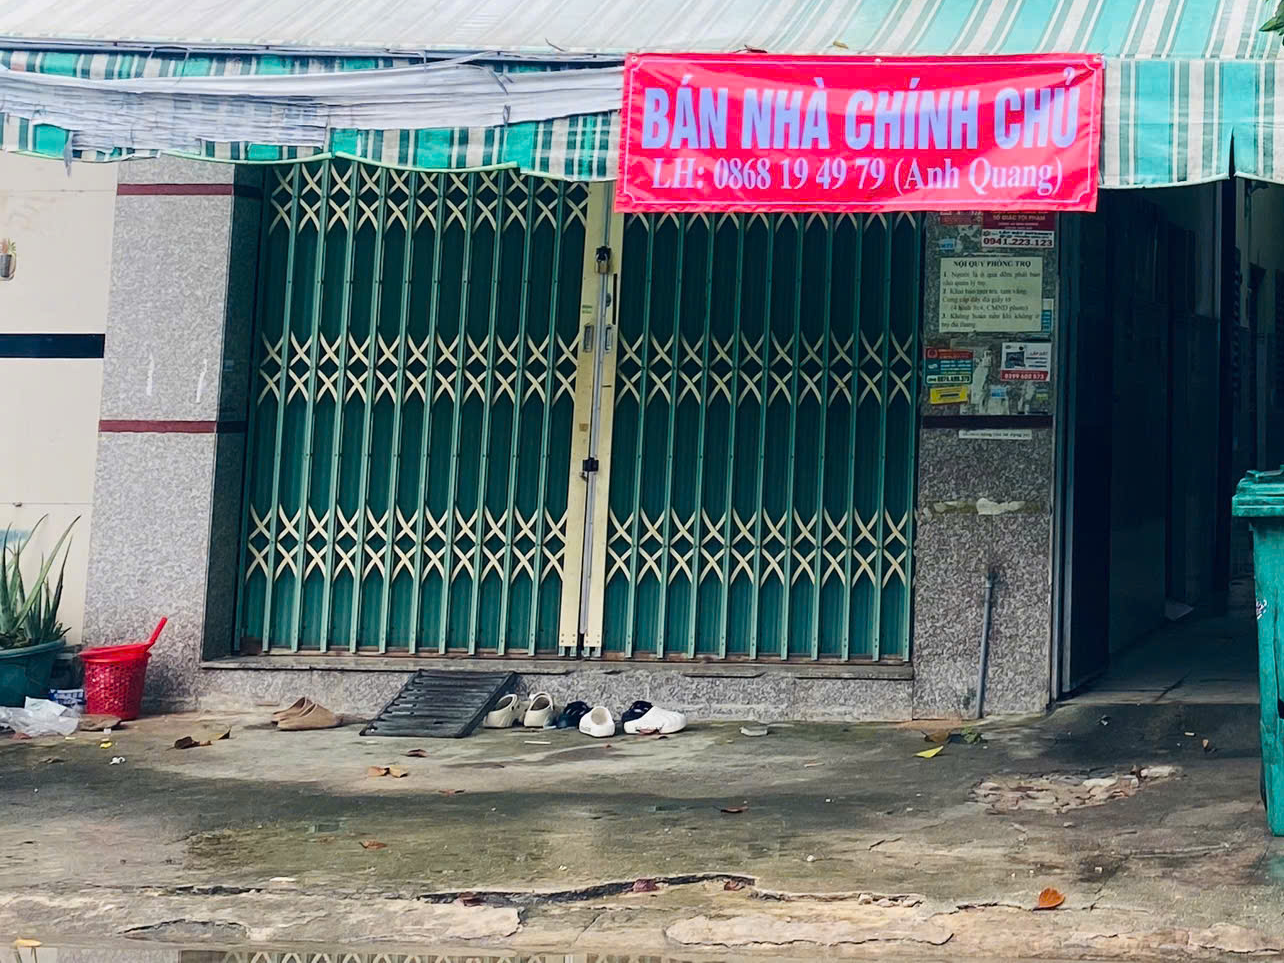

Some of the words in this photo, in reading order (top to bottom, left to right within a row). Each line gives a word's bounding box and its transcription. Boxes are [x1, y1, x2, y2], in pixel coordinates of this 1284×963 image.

[641, 74, 728, 149] BÁN
[741, 77, 830, 149] NHÀ
[845, 77, 979, 150] CHÍNH
[994, 67, 1080, 149] CHỦ
[652, 157, 705, 189] LH:
[713, 157, 771, 190] 0868
[781, 157, 809, 190] 19
[816, 157, 847, 190] 49
[855, 157, 886, 190] 79
[894, 157, 960, 196] (Anh
[968, 156, 1063, 196] Quang)
[983, 237, 1053, 247] 0941.223.123
